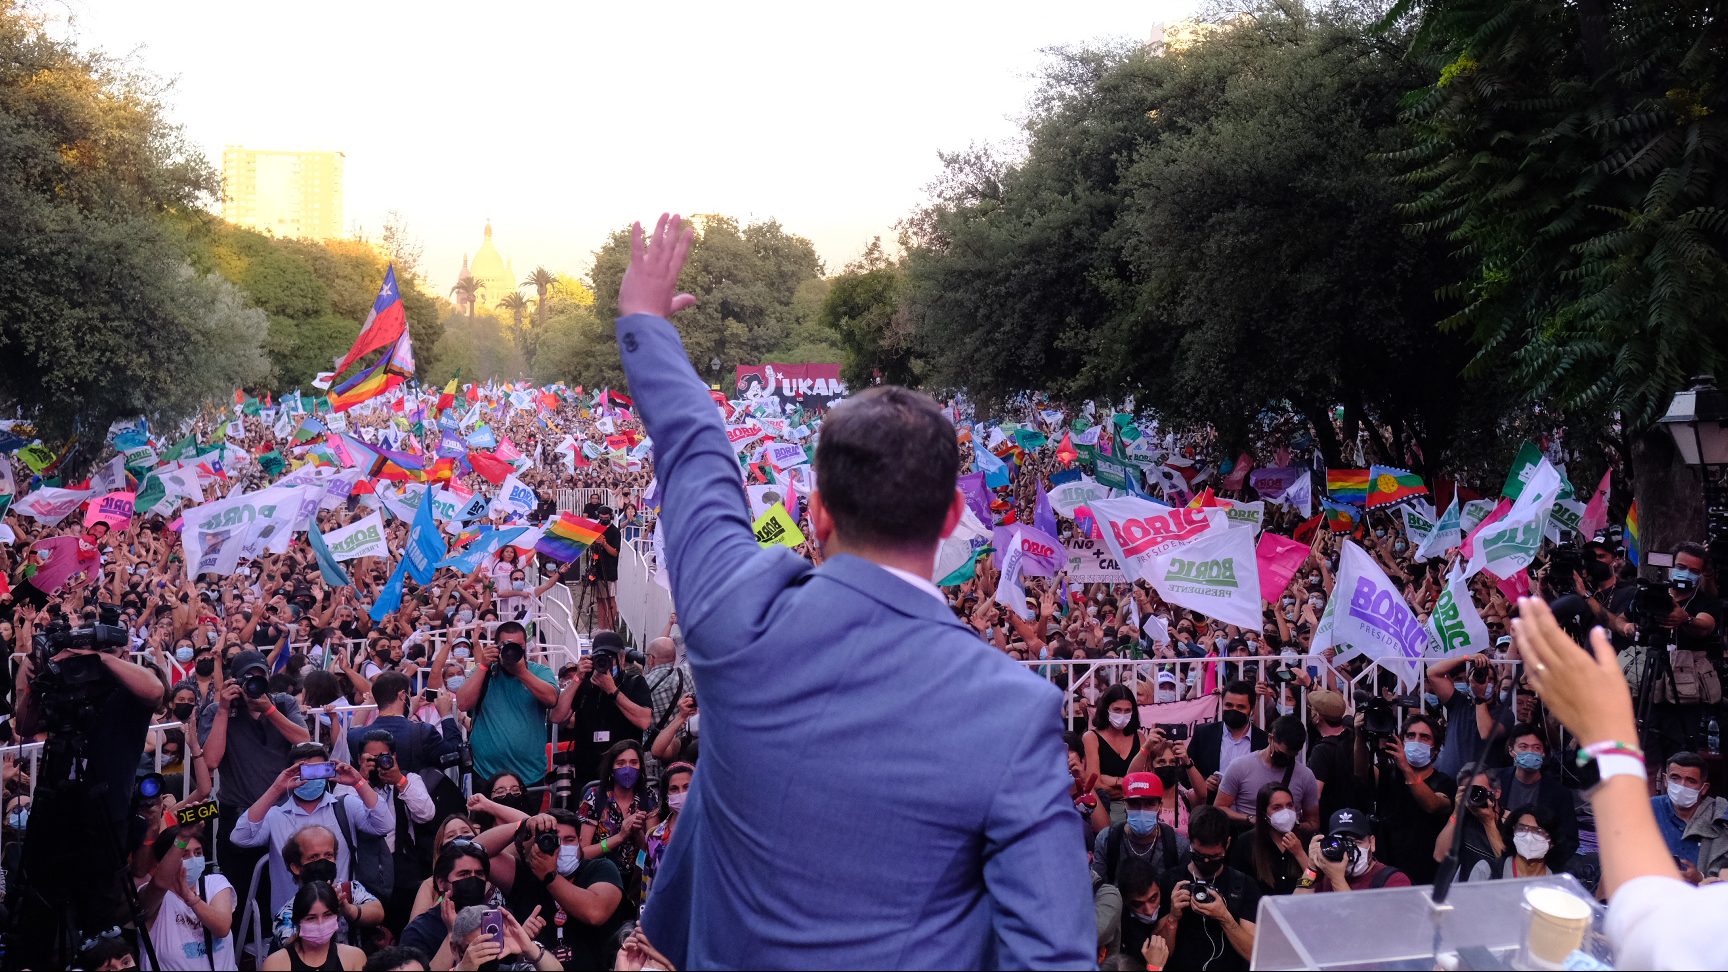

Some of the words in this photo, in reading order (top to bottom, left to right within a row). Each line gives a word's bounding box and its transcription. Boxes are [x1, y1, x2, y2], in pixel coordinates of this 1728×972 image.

[1226, 508, 1260, 519] ORIC
[1108, 507, 1209, 548] BORIC
[1021, 539, 1055, 557] ORIC
[1073, 540, 1094, 550] NO
[1351, 576, 1428, 658] BORIC
[1438, 590, 1472, 650] ORIC
[1360, 622, 1400, 651] PRESIDE
[198, 804, 218, 818] GA
